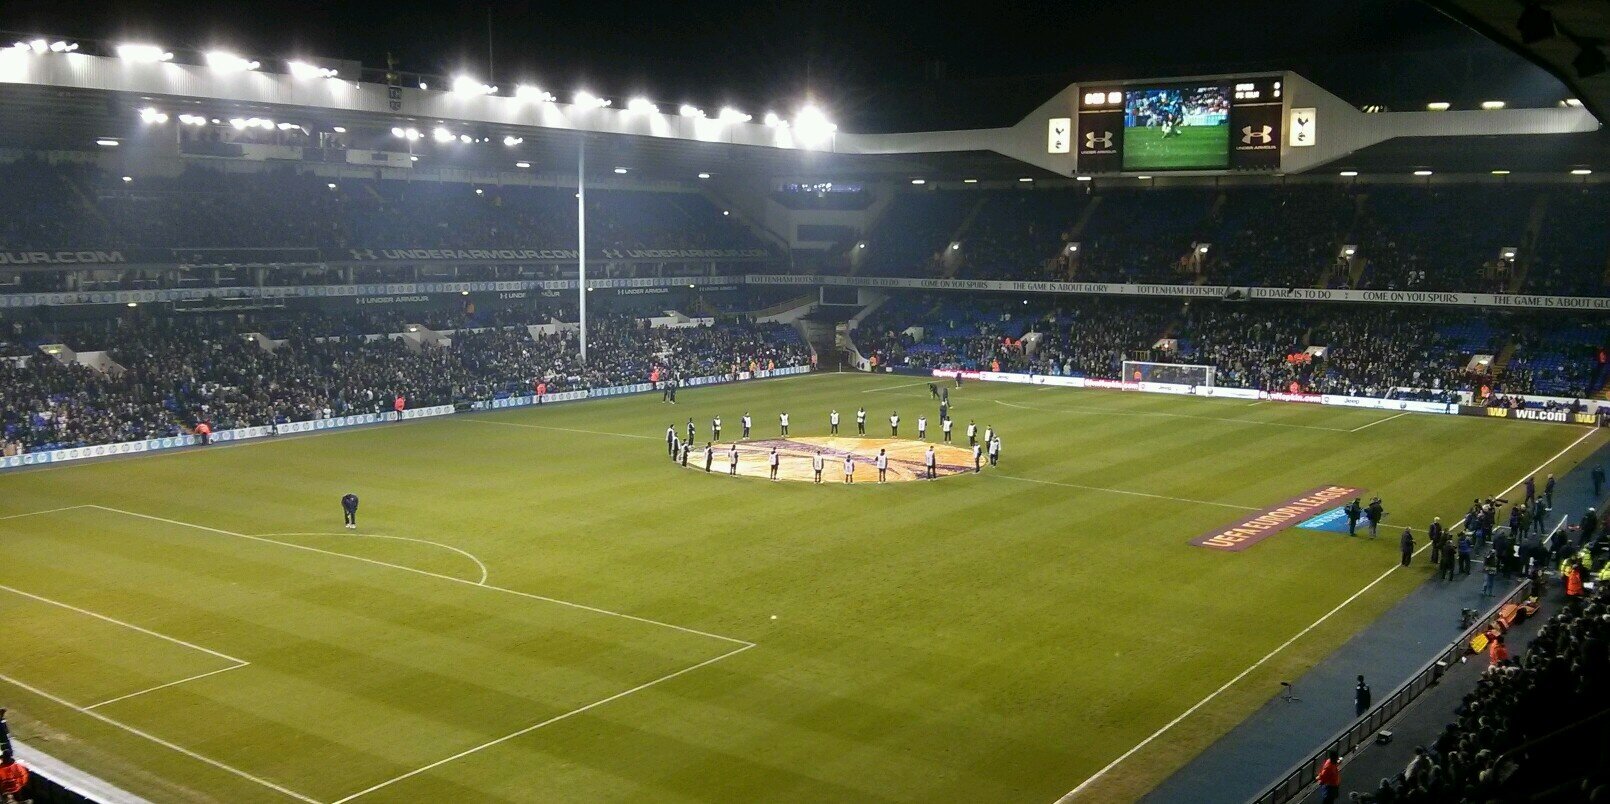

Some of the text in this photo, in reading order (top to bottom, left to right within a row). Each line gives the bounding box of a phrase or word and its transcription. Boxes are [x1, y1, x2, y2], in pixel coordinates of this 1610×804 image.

[382, 249, 579, 259] UNDERARMOUR.COM
[751, 276, 793, 284] TOTTENHAM
[966, 281, 988, 289] SPURS
[1013, 282, 1026, 290] THE
[1049, 283, 1056, 291] IS
[1057, 283, 1083, 291] ABOUT
[1084, 284, 1109, 292] GLORY
[1137, 285, 1224, 295] TOTTENHAM HOTSPUR
[1255, 289, 1267, 297] TO
[1294, 290, 1302, 298] IS
[1303, 291, 1316, 299] TO
[1317, 291, 1331, 299] DO
[1363, 292, 1458, 303] COME ON YOU SPURS
[1493, 296, 1511, 304] THE
[1514, 296, 1542, 306] GAME
[1545, 297, 1554, 306] IS
[1556, 298, 1590, 307] ABOUT
[1344, 397, 1360, 405] Jeep
[1515, 408, 1567, 422] wu.com
[1202, 526, 1262, 547] UEFA
[1241, 505, 1312, 530] EUROPA
[1293, 486, 1355, 507] LEAGUE
